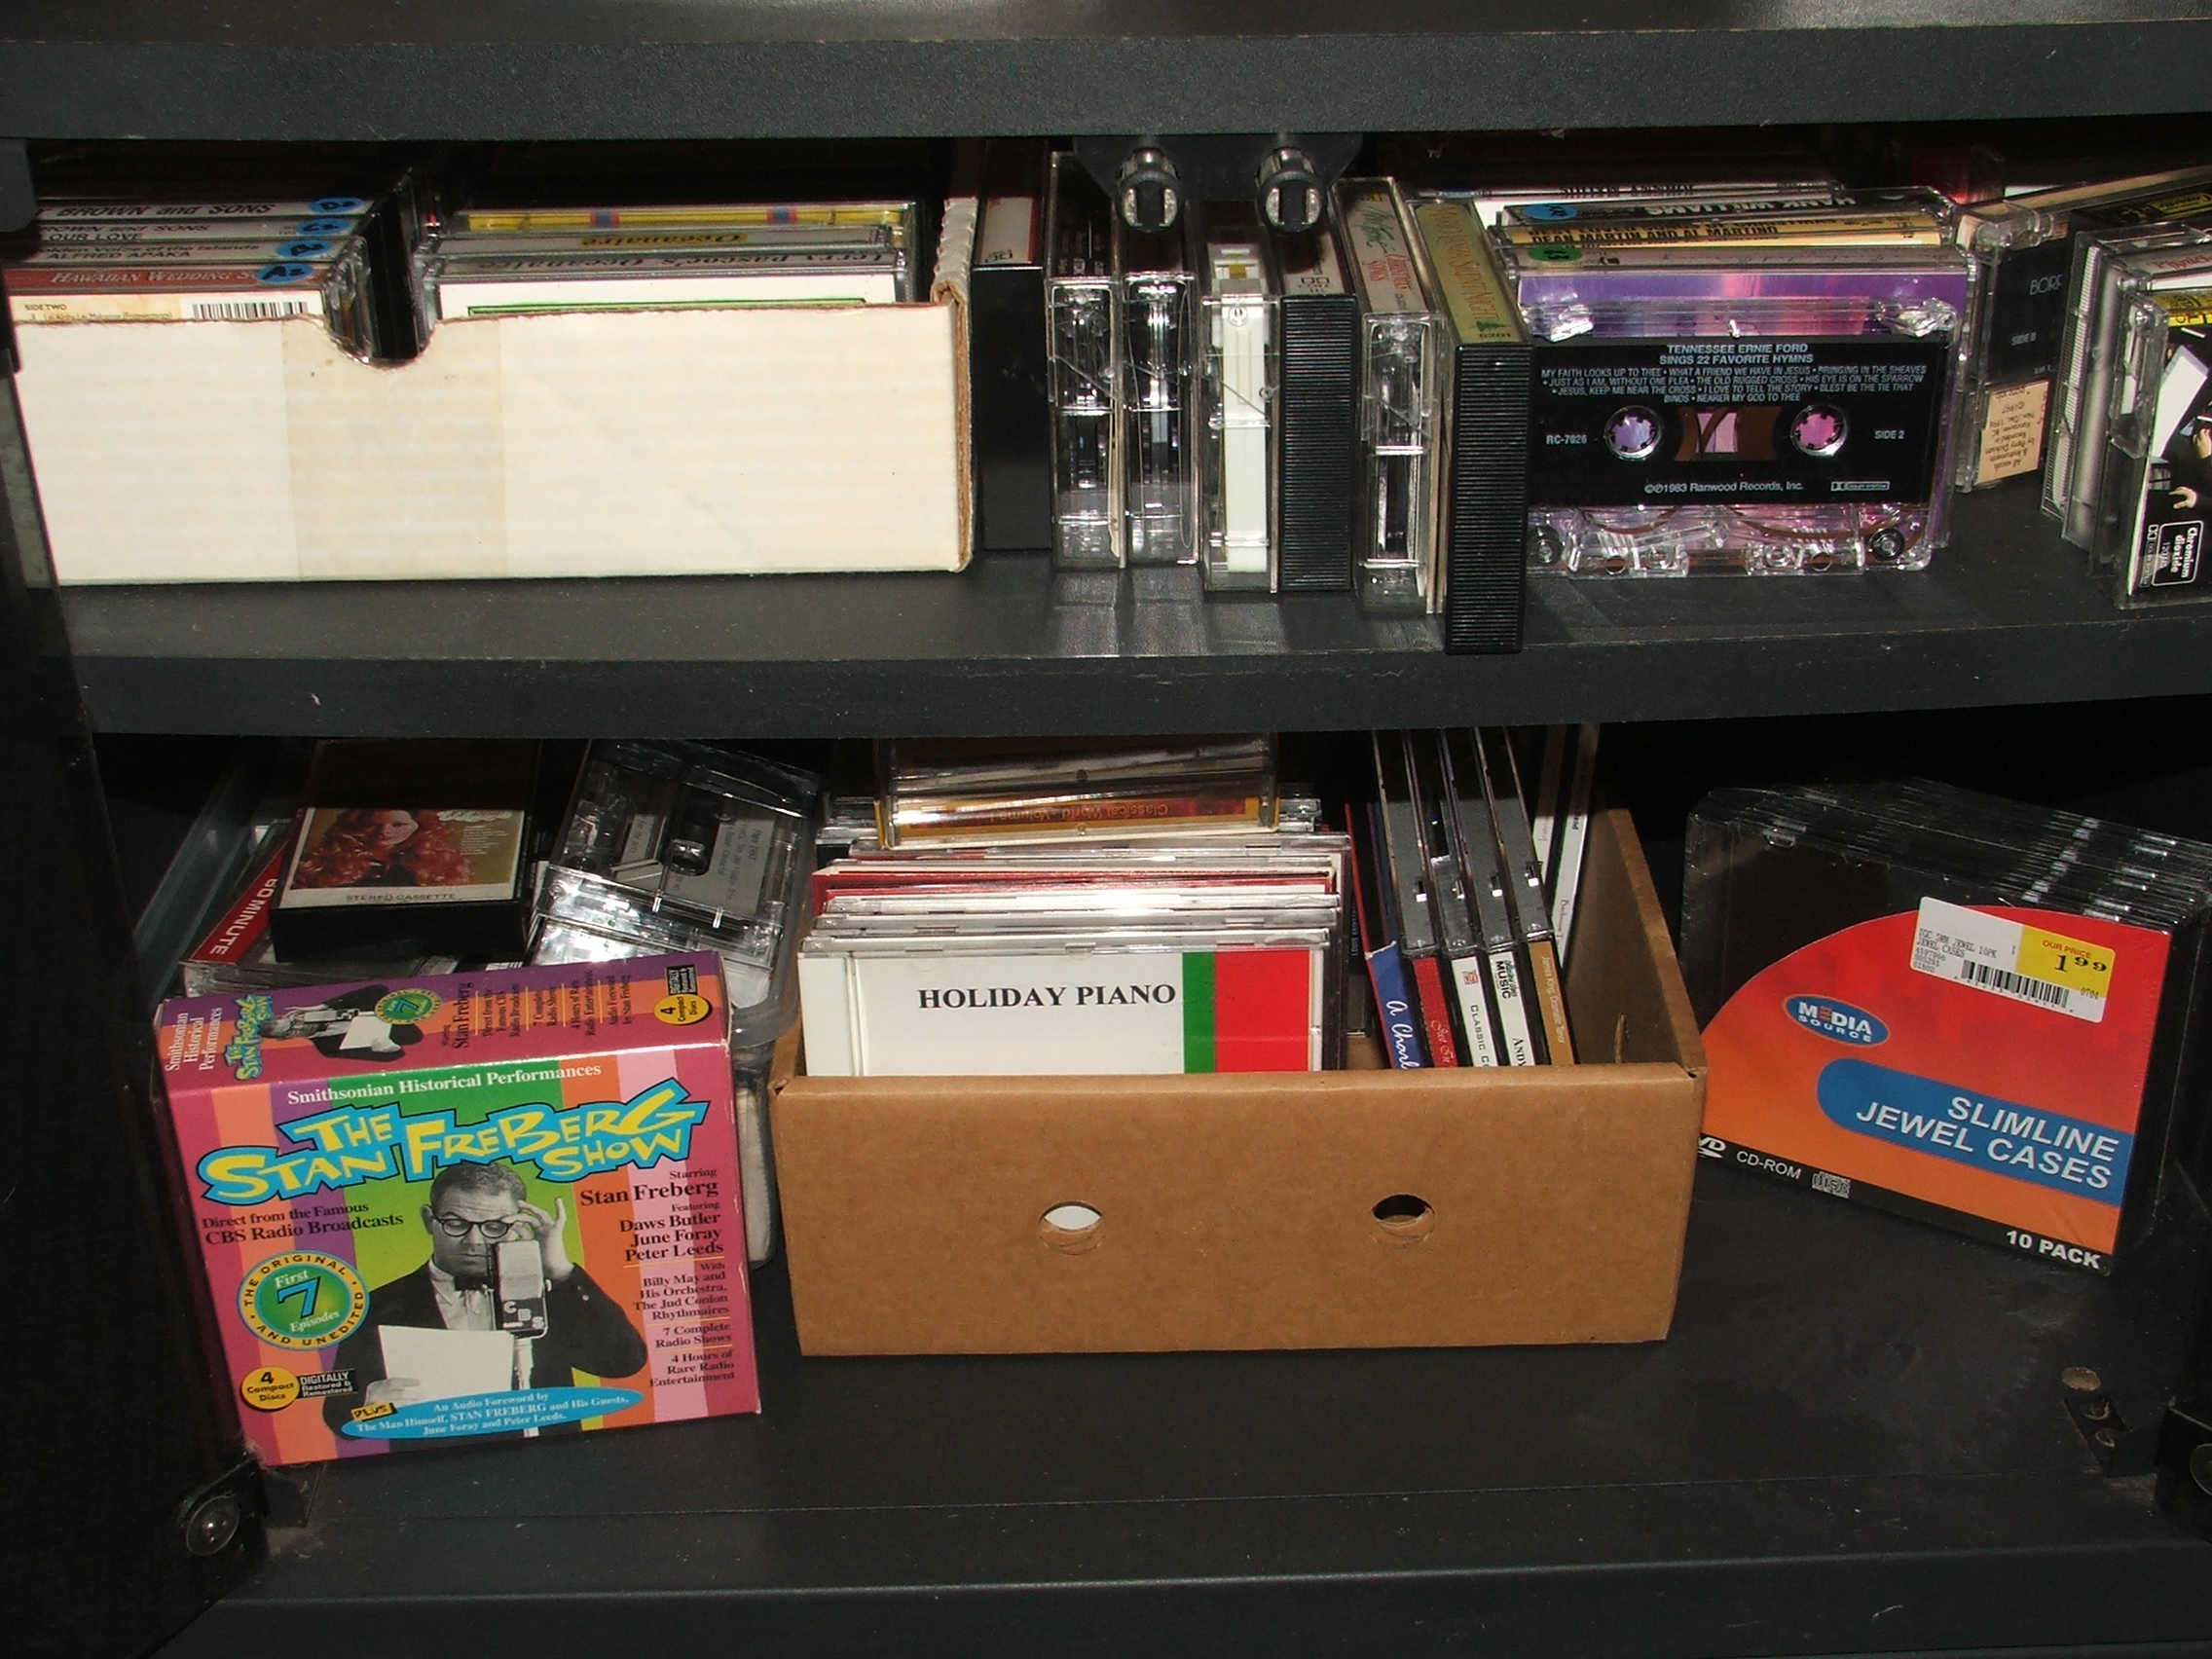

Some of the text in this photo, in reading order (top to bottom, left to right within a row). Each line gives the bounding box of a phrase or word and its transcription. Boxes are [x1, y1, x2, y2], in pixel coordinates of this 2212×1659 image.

[1660, 354, 1814, 365] SINGS 22 FAVORITE HYMNS
[1667, 344, 1808, 354] TENNESSEE ERNIE FORD
[1609, 377, 1647, 386] WITHOUT
[1733, 375, 1768, 384] RUGGED
[1875, 430, 1905, 439] SIDE 2
[1689, 483, 1737, 493] Ranwood
[2169, 534, 2186, 573] dioxide
[2180, 527, 2198, 579] Chromium
[209, 898, 269, 955] MINUTE
[2043, 939, 2091, 959] OUR PRICE
[1495, 960, 1512, 1000] MUSIC
[917, 983, 1176, 1010] HOLIDAY PIANO
[453, 981, 474, 1049] Stan Freberg
[1798, 1002, 1872, 1035] MEDIA
[199, 1007, 222, 1071] Performances
[1470, 1005, 1486, 1051] CLASSIC
[1797, 1015, 1872, 1043] SOURCE
[166, 1013, 189, 1071] Smithsonian
[183, 1016, 204, 1063] Historical
[1391, 1023, 1419, 1070] Charl
[288, 1063, 602, 1104] Smithsonian Historical Performances
[293, 1113, 393, 1153] THE
[1947, 1094, 2120, 1162] SLIMLINE
[204, 1088, 697, 1198] STAN FREBERG
[541, 1129, 682, 1176] SHOW
[1856, 1101, 2114, 1190] JEWEL CASES
[670, 1170, 718, 1180] Starring
[1736, 1150, 1802, 1180] CD-ROM
[580, 1181, 719, 1206] Stan Freberg
[203, 1202, 369, 1229] Direct from the Famous
[671, 1202, 719, 1212] Featuring
[204, 1214, 404, 1245] CBS Radio Broadcasts
[619, 1213, 721, 1233] Daws Butler
[631, 1229, 721, 1247] June Foray
[625, 1241, 724, 1262] Peter Leeds
[2005, 1230, 2103, 1270] 10 PACK
[244, 1255, 346, 1308] THE ORIGINAL
[274, 1270, 309, 1289] First
[643, 1272, 725, 1287] Billy May and
[276, 1276, 321, 1319] 7
[633, 1296, 728, 1311] The Jud Conlon
[641, 1288, 660, 1299] His
[256, 1292, 364, 1346] AND UNEDITED
[290, 1310, 340, 1333] Episodes
[652, 1308, 729, 1320] Rhythmaires
[674, 1323, 730, 1336] Complete
[655, 1335, 732, 1348] Radio Shows
[667, 1362, 734, 1375] Rare Radio
[682, 1352, 719, 1363] Hours
[246, 1382, 294, 1394] Compact
[260, 1372, 275, 1384] 4
[300, 1371, 350, 1385] DIGITALLY
[649, 1373, 735, 1387] Entertainment
[259, 1393, 286, 1402] Discs
[451, 1393, 535, 1412] Audio Foreword
[354, 1404, 387, 1418] PLUS
[450, 1404, 546, 1421] STAN FREBERG
